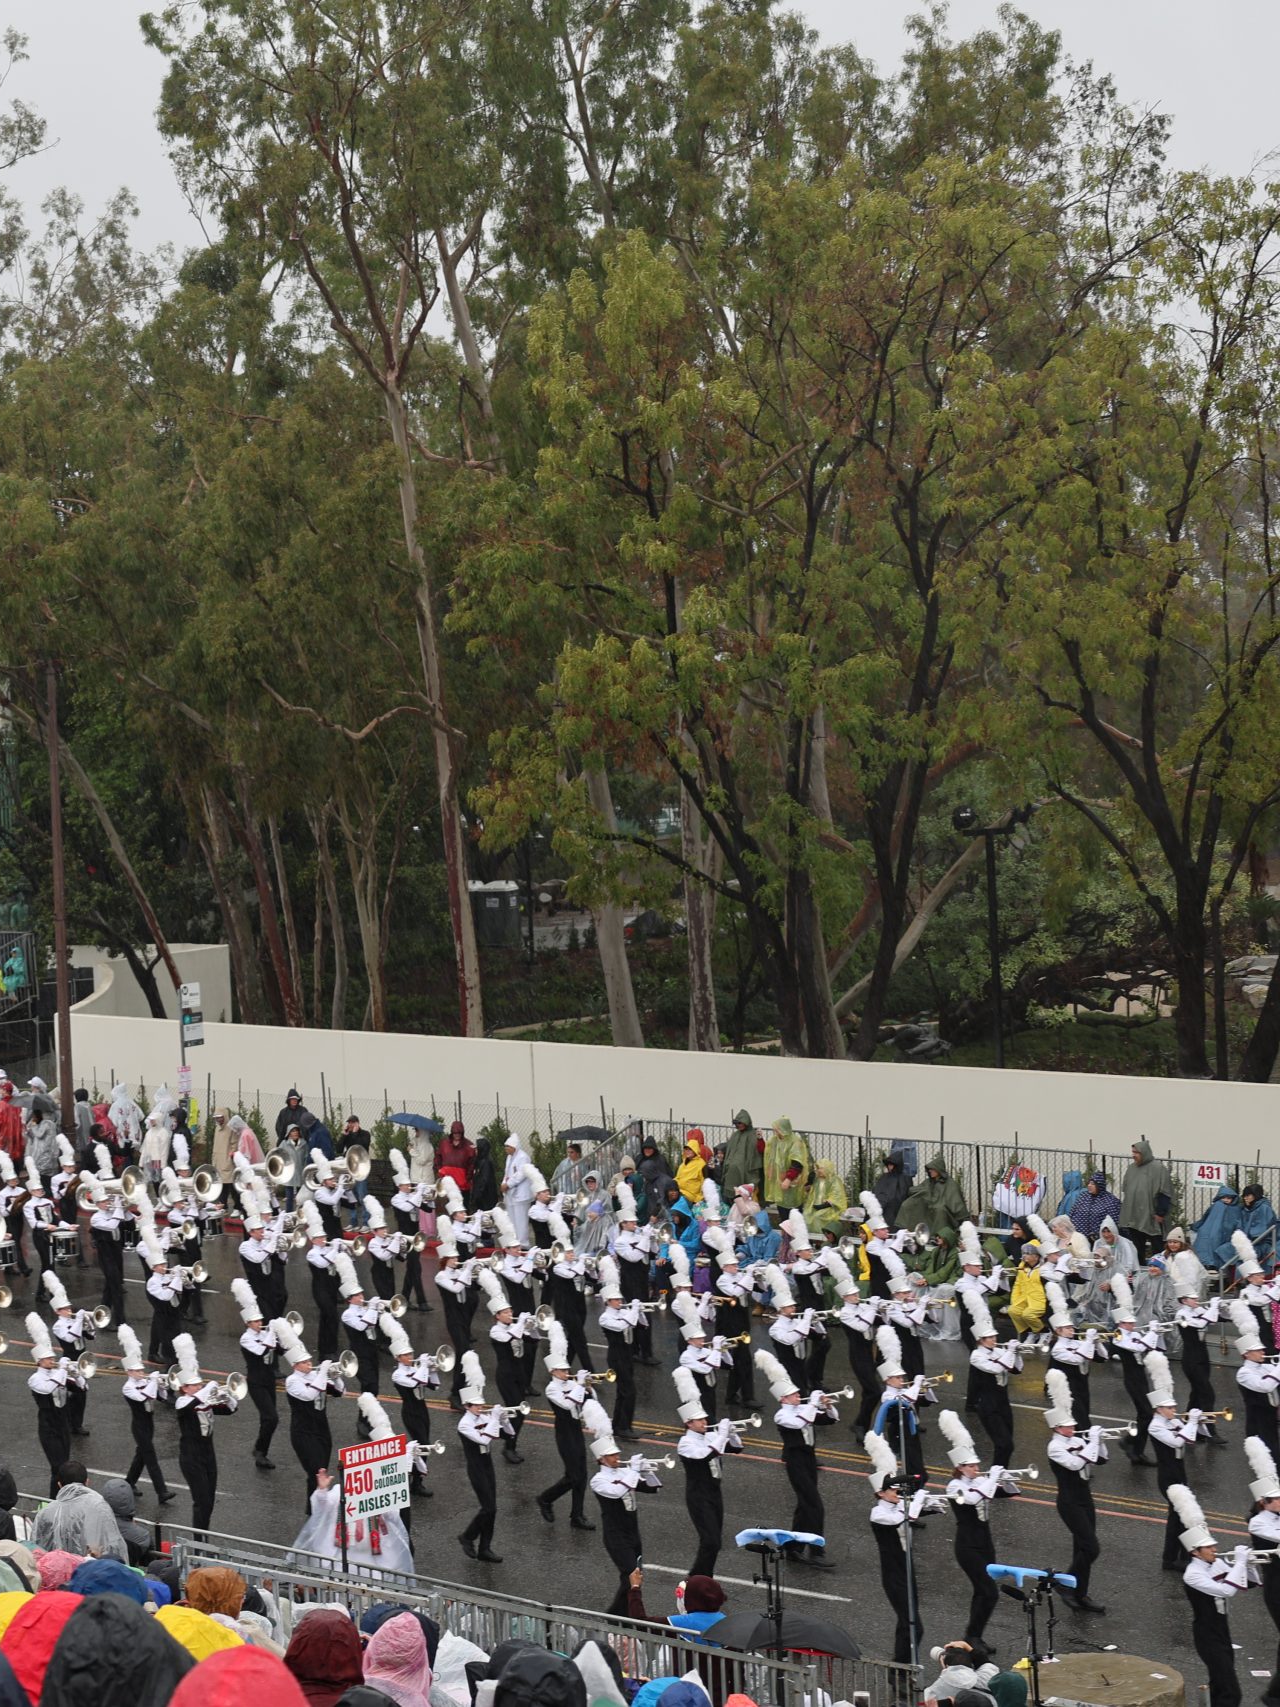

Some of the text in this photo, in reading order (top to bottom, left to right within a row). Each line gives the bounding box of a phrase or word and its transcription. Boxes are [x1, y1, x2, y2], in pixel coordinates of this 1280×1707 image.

[1198, 1166, 1221, 1179] 431
[345, 1440, 401, 1465] ENTRANCE
[381, 1463, 398, 1476] WEST
[344, 1468, 373, 1497] 450
[374, 1472, 407, 1490] COLORADO
[358, 1489, 408, 1514] AISLES 7-9
